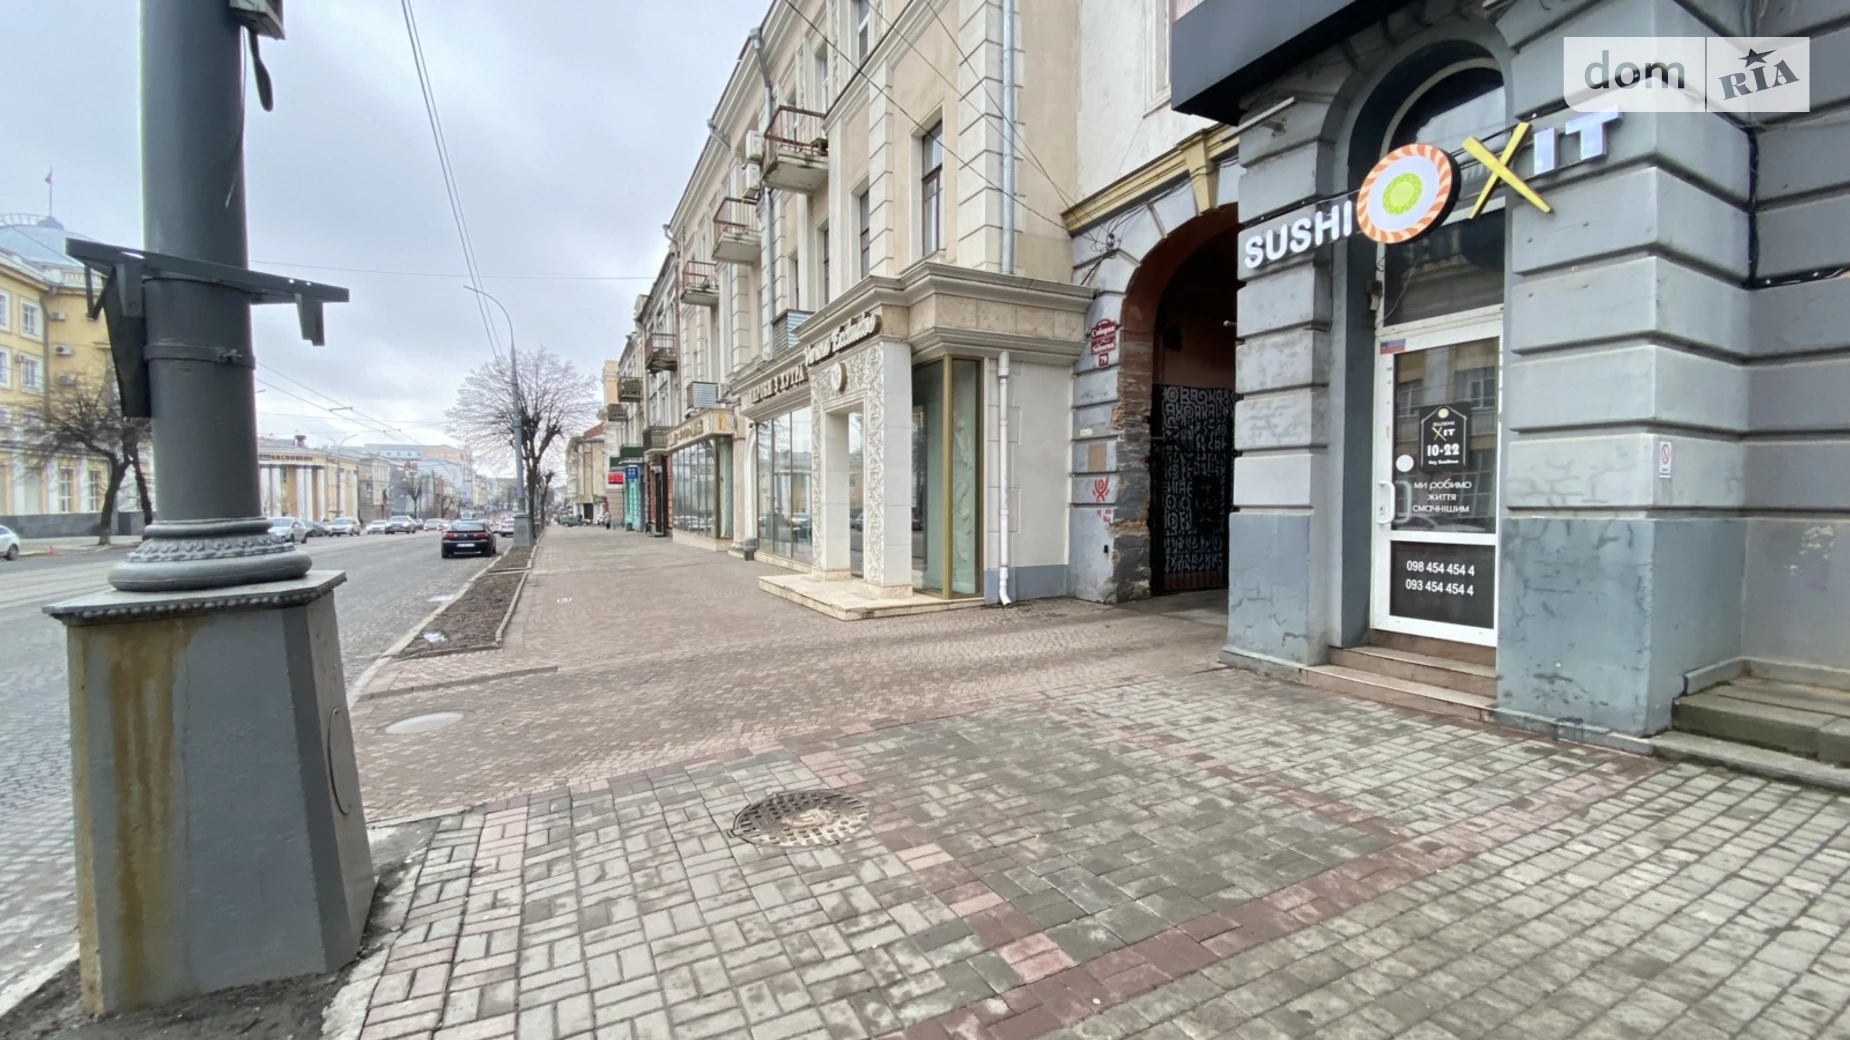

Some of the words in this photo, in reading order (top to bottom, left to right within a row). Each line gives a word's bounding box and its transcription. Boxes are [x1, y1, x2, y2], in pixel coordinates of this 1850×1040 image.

[1244, 199, 1353, 269] SUSHI
[1429, 479, 1472, 490] робимо
[1427, 493, 1457, 501] життя
[1412, 505, 1470, 513] смачнішим
[1406, 560, 1424, 572] 098
[1426, 561, 1444, 574] 454
[1446, 563, 1466, 576] 454
[1468, 565, 1475, 577] 4
[1405, 578, 1423, 591] 093
[1425, 580, 1443, 593] 454
[1445, 582, 1465, 595] 454
[1466, 584, 1474, 597] 4
